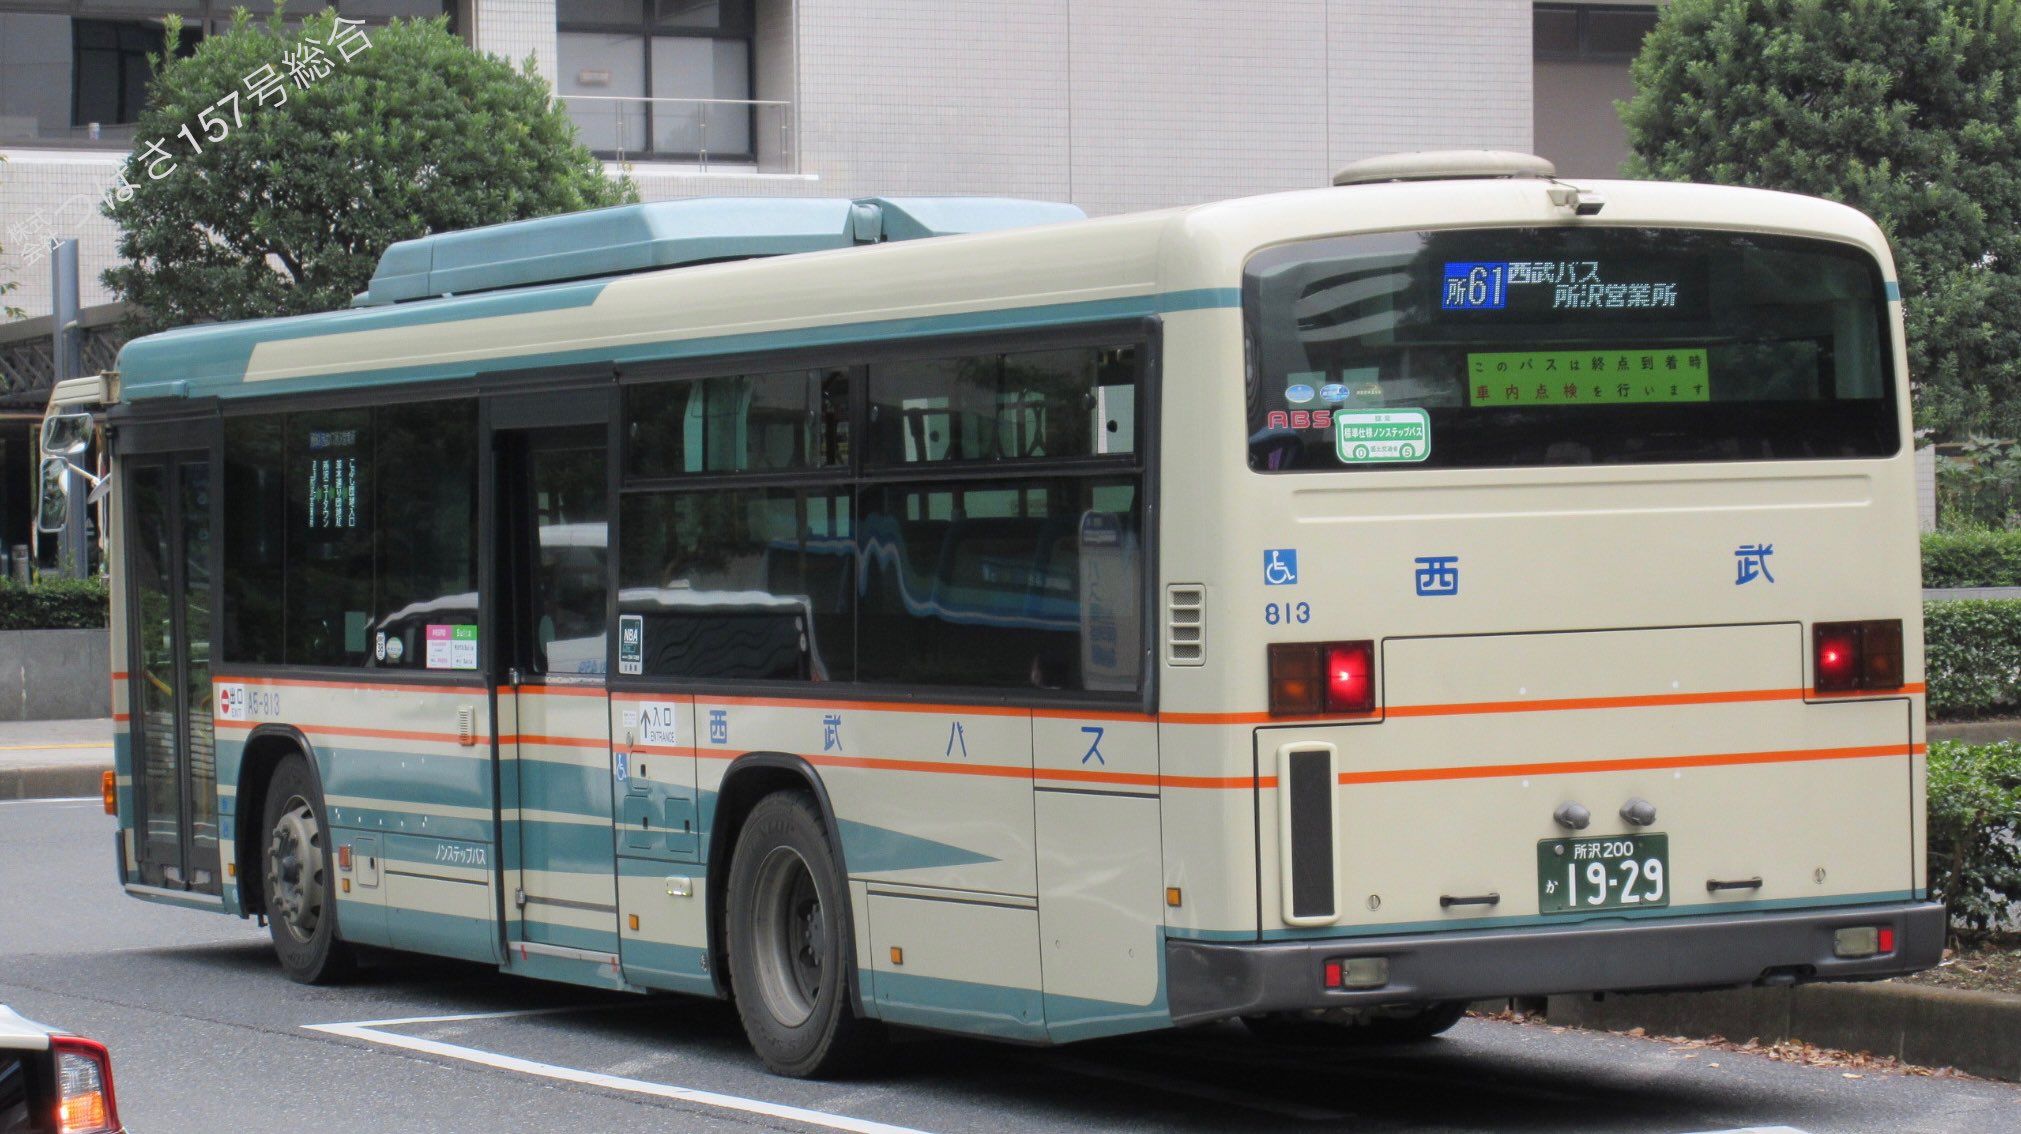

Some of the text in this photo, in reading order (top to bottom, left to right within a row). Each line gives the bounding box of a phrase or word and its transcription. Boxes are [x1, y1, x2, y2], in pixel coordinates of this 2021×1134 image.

[1508, 261, 1601, 284] 西武バス
[1553, 282, 1678, 308] 所沢営業所
[1475, 355, 1703, 372] このバスは終点到着時
[1475, 383, 1704, 401] 車内点検を行います
[1268, 410, 1331, 429] ABS
[1265, 601, 1311, 625] 813
[623, 629, 638, 642] NBA
[230, 688, 243, 704] 出口
[653, 707, 671, 726] 入口
[650, 731, 674, 743] ENTRANCE
[435, 843, 486, 865] ノンステップバス
[1545, 879, 1559, 894] か
[1568, 858, 1664, 907] 19-29
